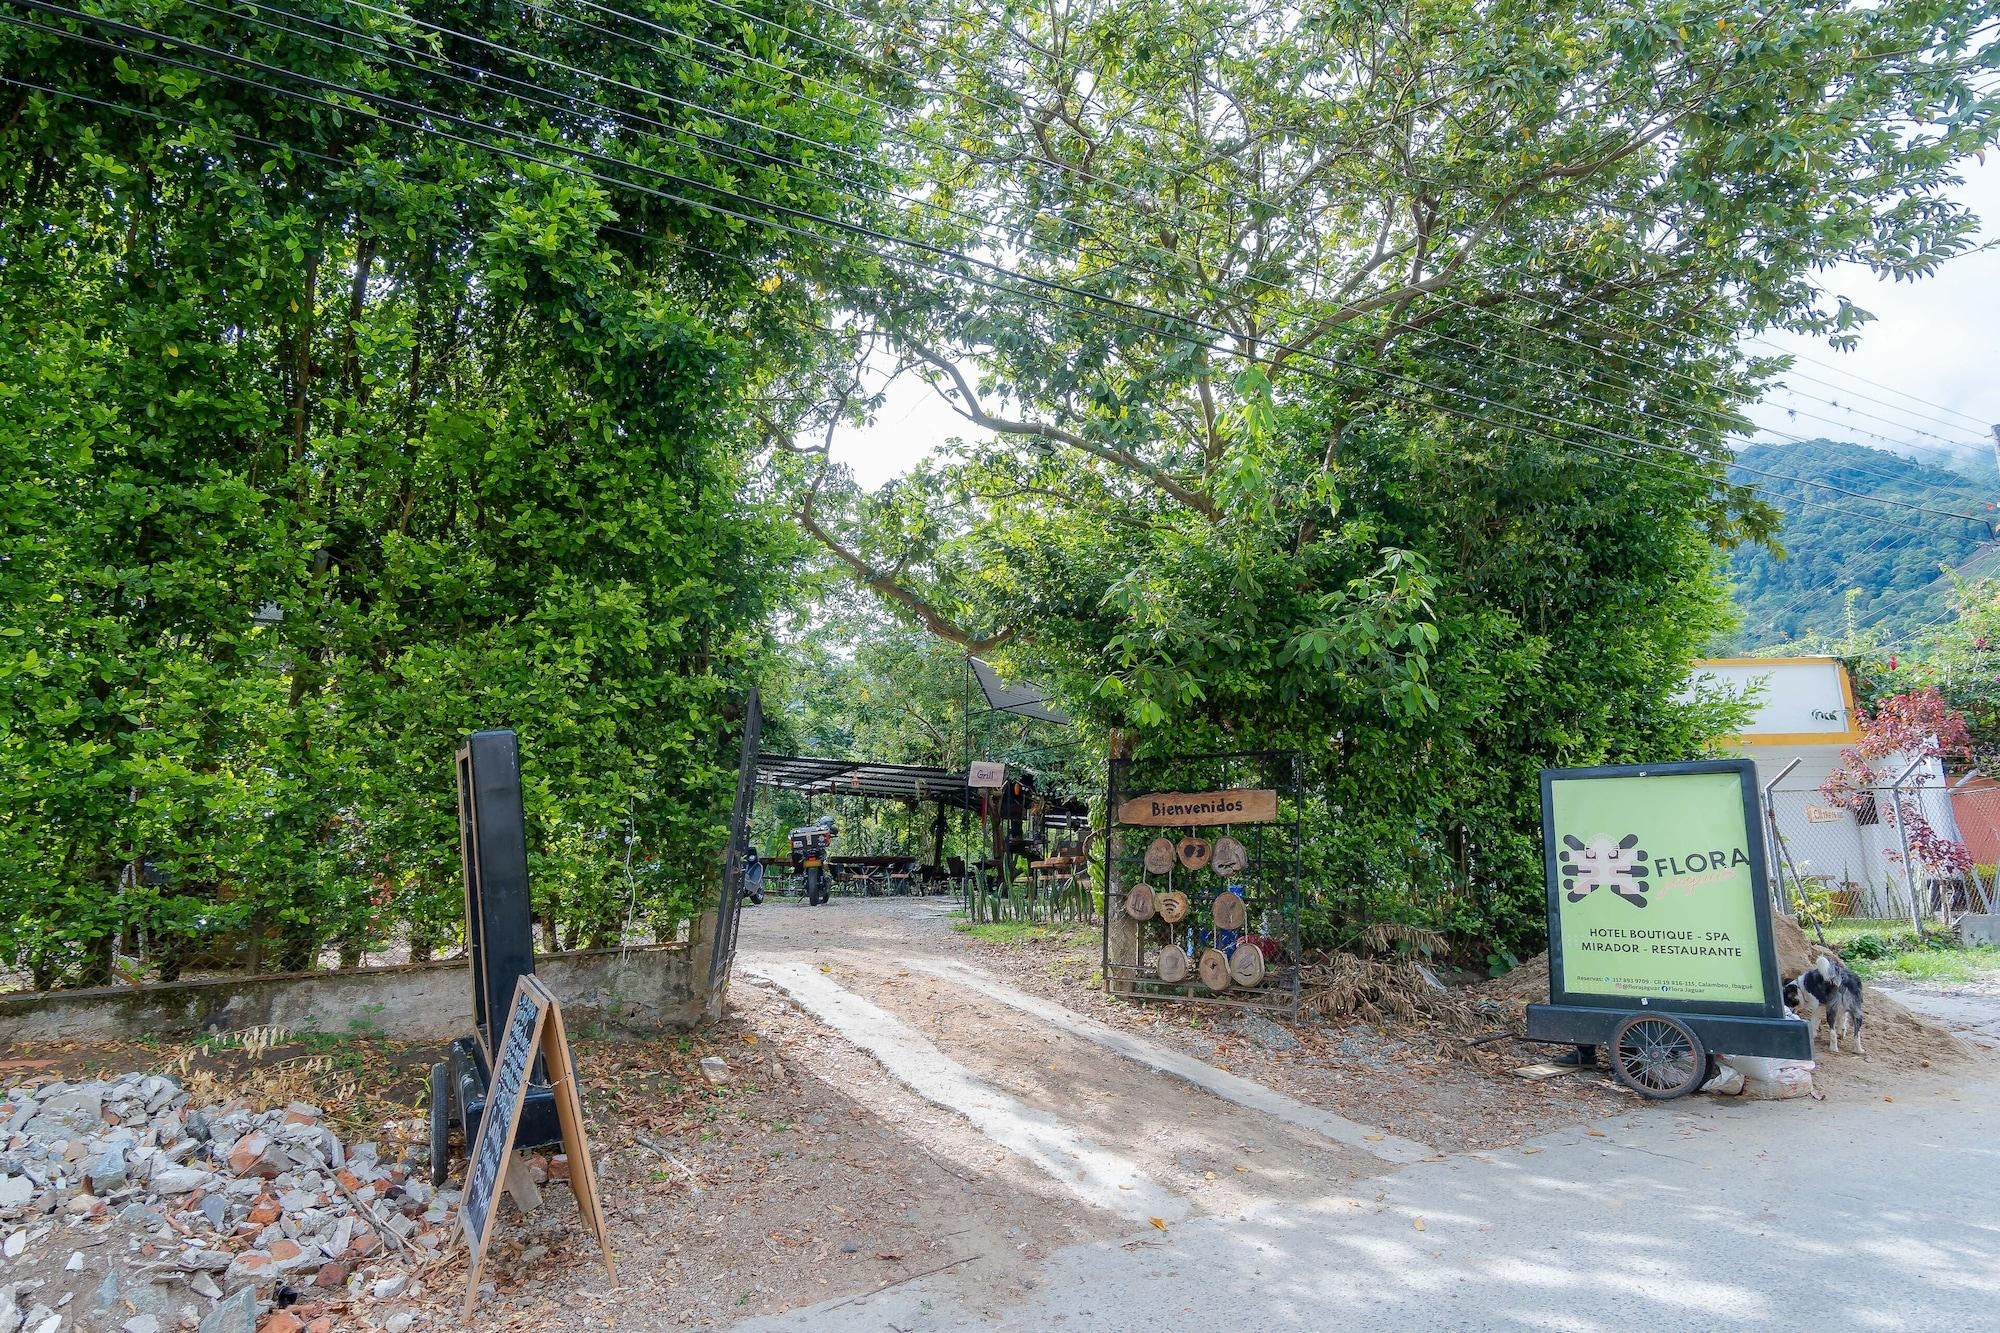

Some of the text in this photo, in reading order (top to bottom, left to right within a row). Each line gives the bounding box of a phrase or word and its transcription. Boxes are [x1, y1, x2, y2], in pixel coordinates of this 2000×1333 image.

[977, 770, 993, 779] Grill
[1152, 799, 1243, 817] Bienvenidos
[1654, 848, 1750, 877] FLORA
[1589, 928, 1627, 938] HOTEL
[1630, 930, 1693, 940] BOUTIQUE
[1705, 932, 1731, 942] SPA
[1581, 942, 1640, 953] MIRADOR
[1651, 945, 1742, 957] RESTAURANTE
